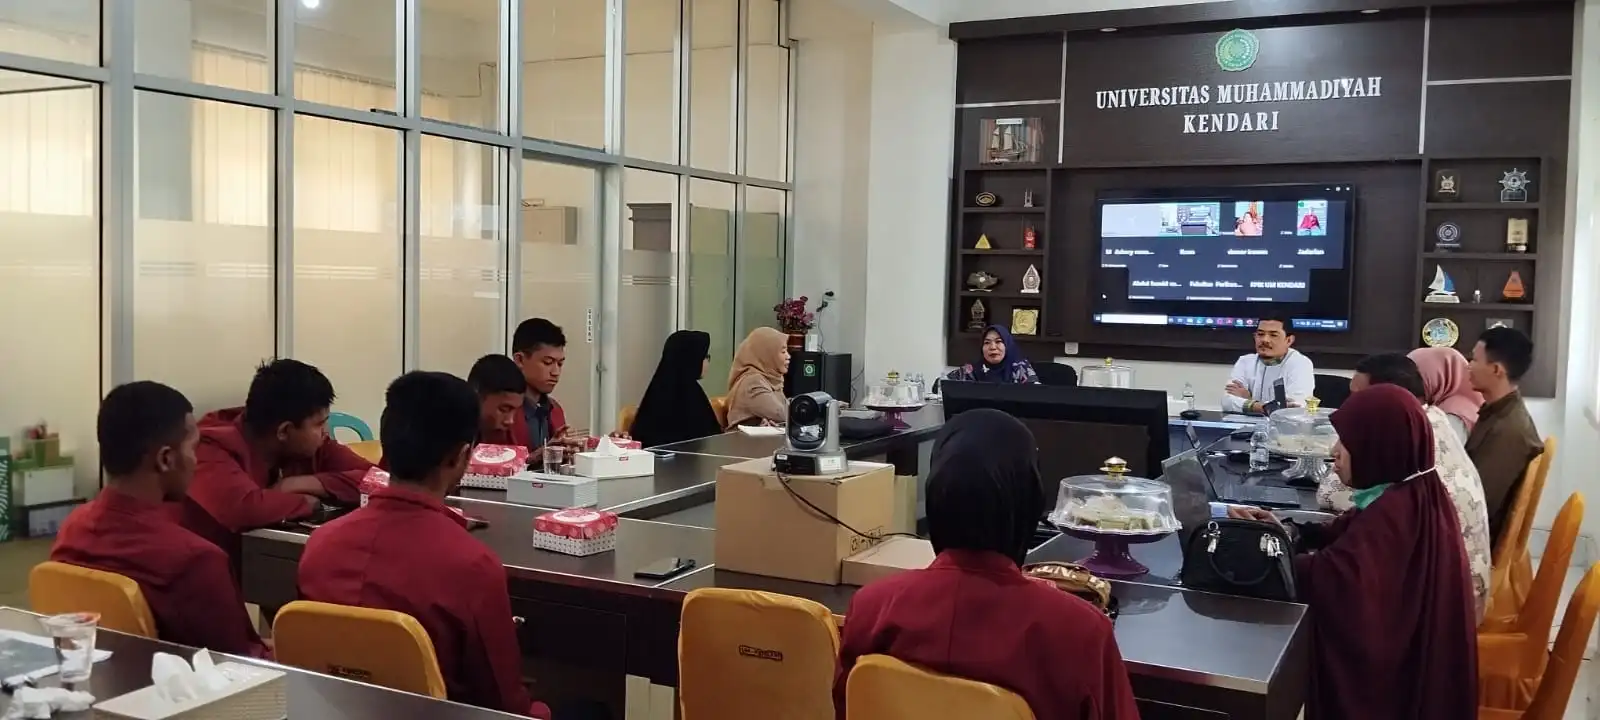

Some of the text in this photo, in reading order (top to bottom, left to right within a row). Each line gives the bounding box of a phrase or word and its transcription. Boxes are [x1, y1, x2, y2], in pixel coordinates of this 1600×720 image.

[1096, 77, 1382, 109] UNIVERSITAS MUHAMMADIYAH
[1183, 111, 1279, 133] KENDARI
